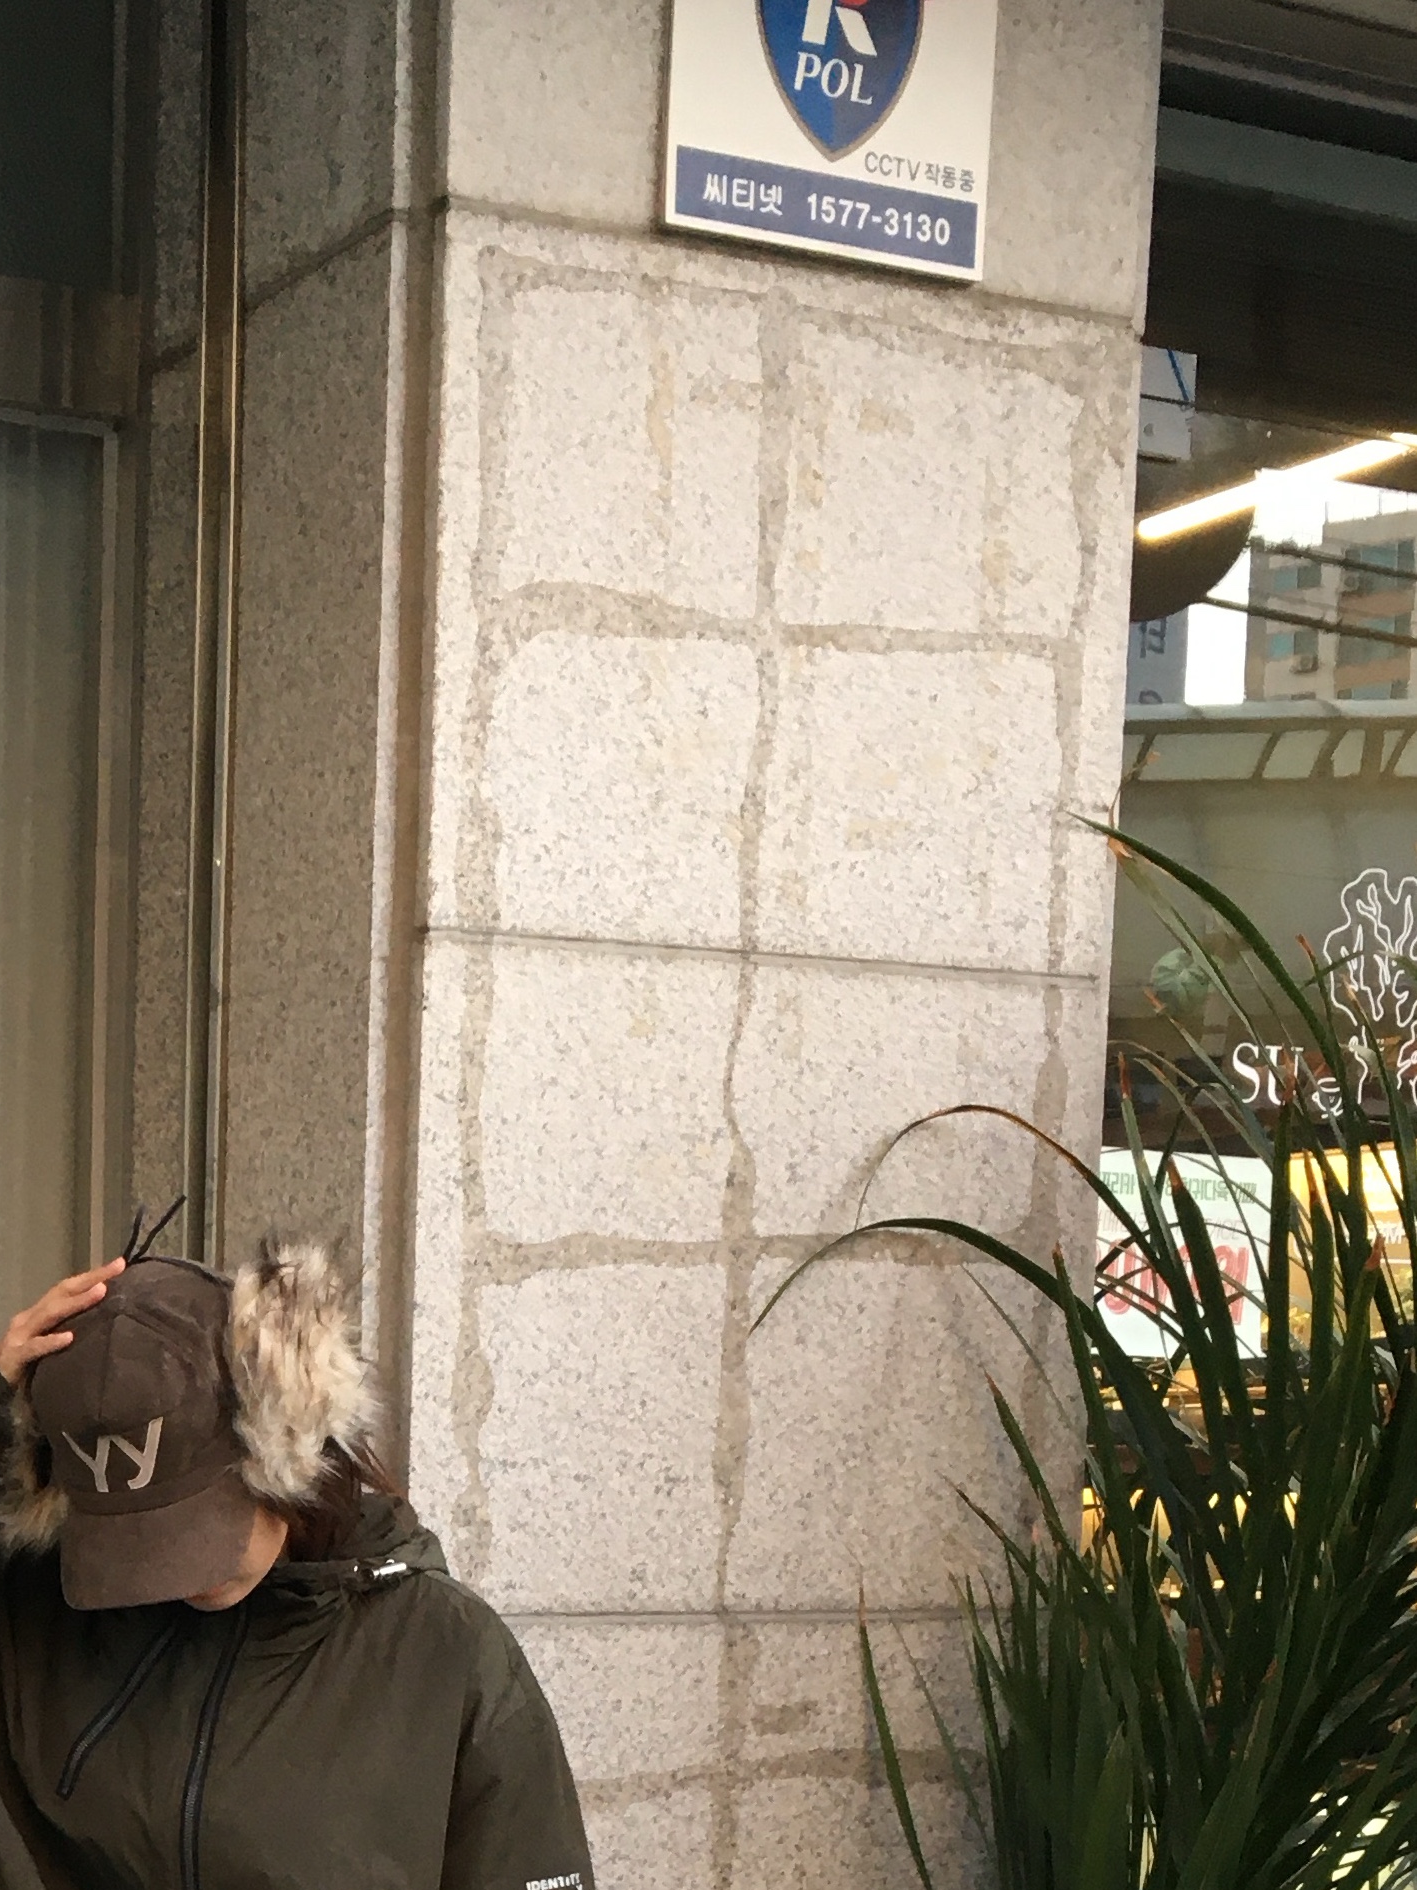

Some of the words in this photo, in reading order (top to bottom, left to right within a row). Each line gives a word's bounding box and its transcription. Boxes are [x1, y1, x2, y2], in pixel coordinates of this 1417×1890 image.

[793, 51, 873, 105] POL
[864, 151, 921, 183] CCTV
[923, 162, 976, 193] 작동중
[702, 172, 784, 217] 씨티넷
[806, 192, 952, 246] 1577-3130
